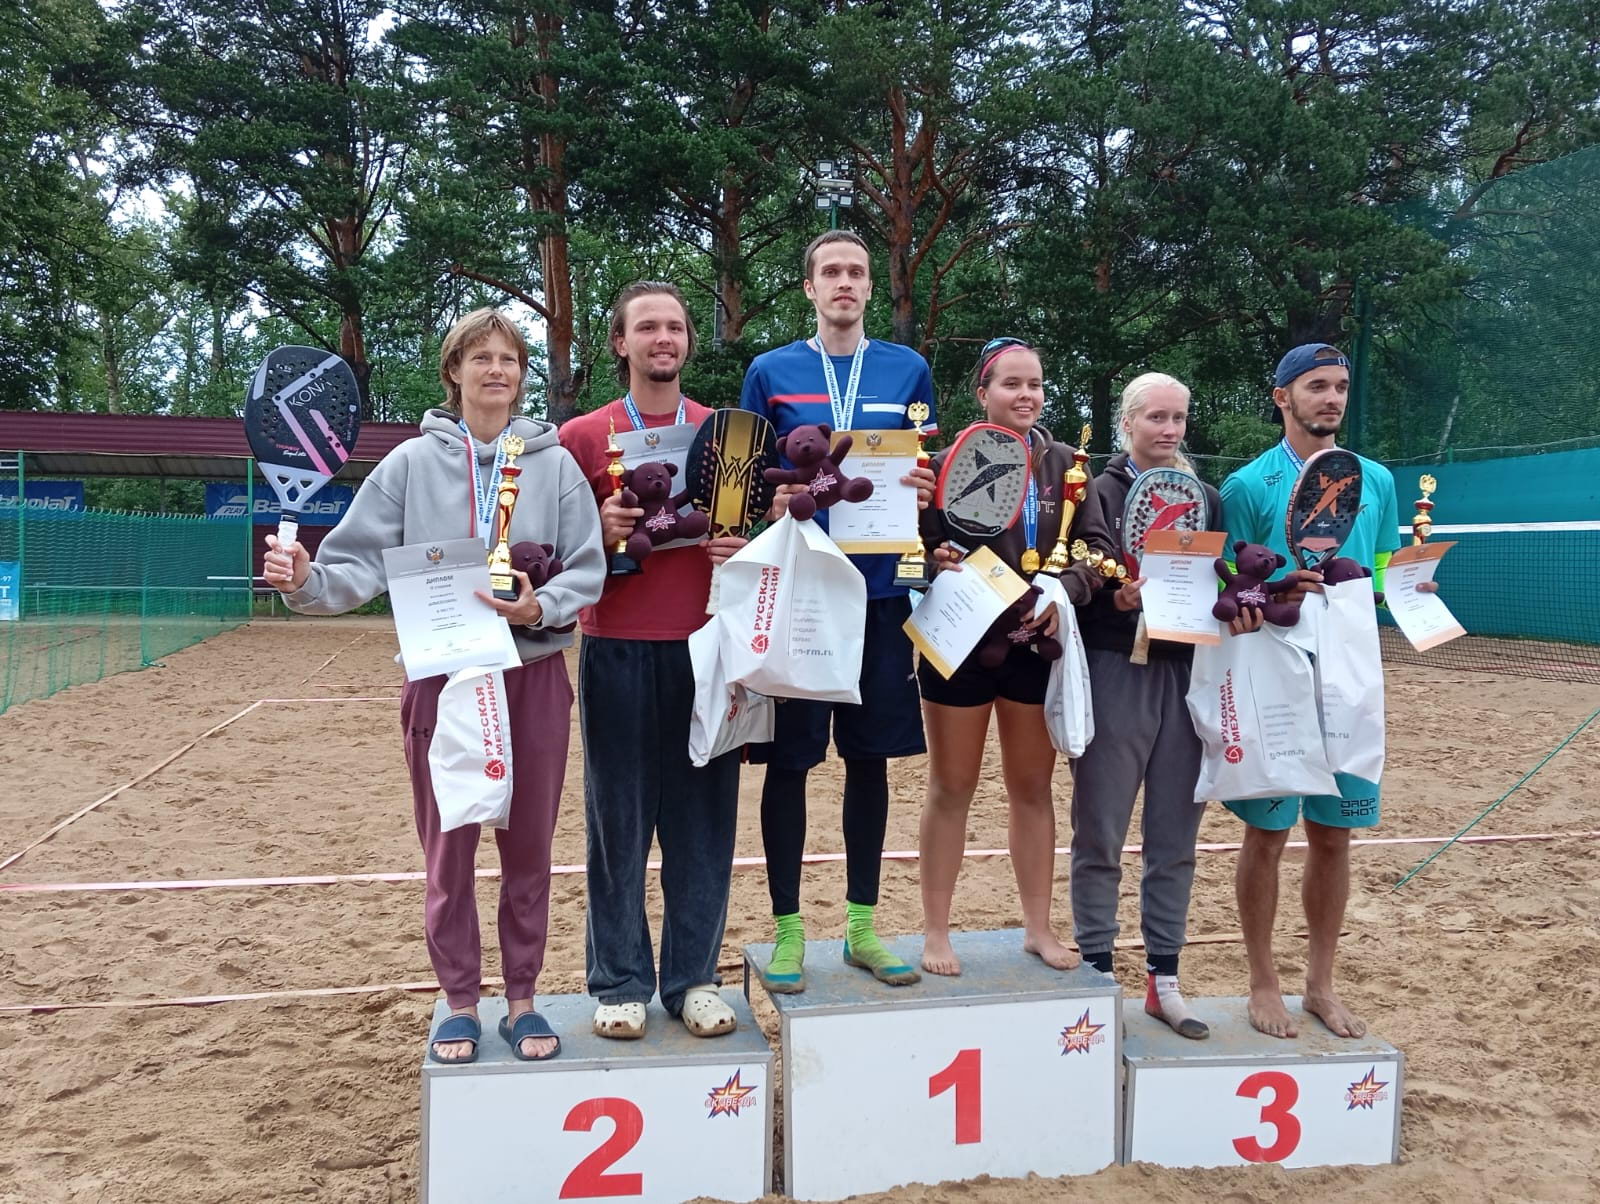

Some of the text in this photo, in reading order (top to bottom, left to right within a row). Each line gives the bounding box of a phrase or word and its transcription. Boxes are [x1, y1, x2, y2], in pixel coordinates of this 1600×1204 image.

[252, 499, 345, 515] BaolaT
[754, 567, 769, 631] РУССКАЯ
[475, 686, 494, 757] РУССКАЯ
[485, 672, 504, 756] МЕХАНИКА
[1219, 684, 1230, 743] РУССКАЯ
[1226, 668, 1241, 742] МЕХАНИКА
[1340, 797, 1376, 809] DROP
[928, 1048, 982, 1145] 1
[1231, 1070, 1301, 1164] 3
[558, 1096, 644, 1200] 2
